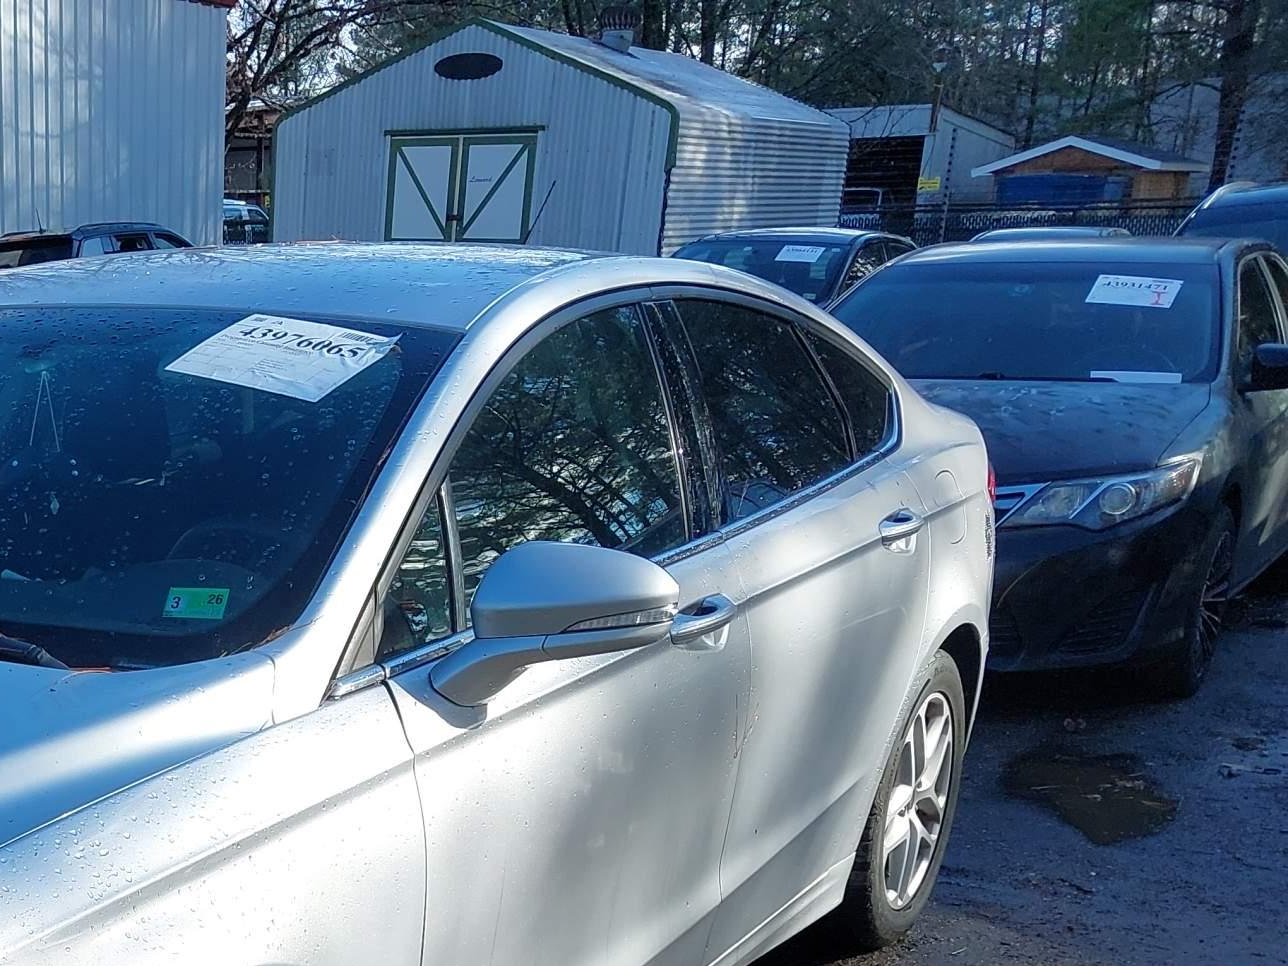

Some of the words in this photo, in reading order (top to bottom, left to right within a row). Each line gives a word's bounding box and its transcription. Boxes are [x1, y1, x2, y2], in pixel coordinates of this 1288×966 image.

[239, 326, 367, 359] 43976065
[170, 596, 181, 609] 3
[207, 594, 224, 605] 26
